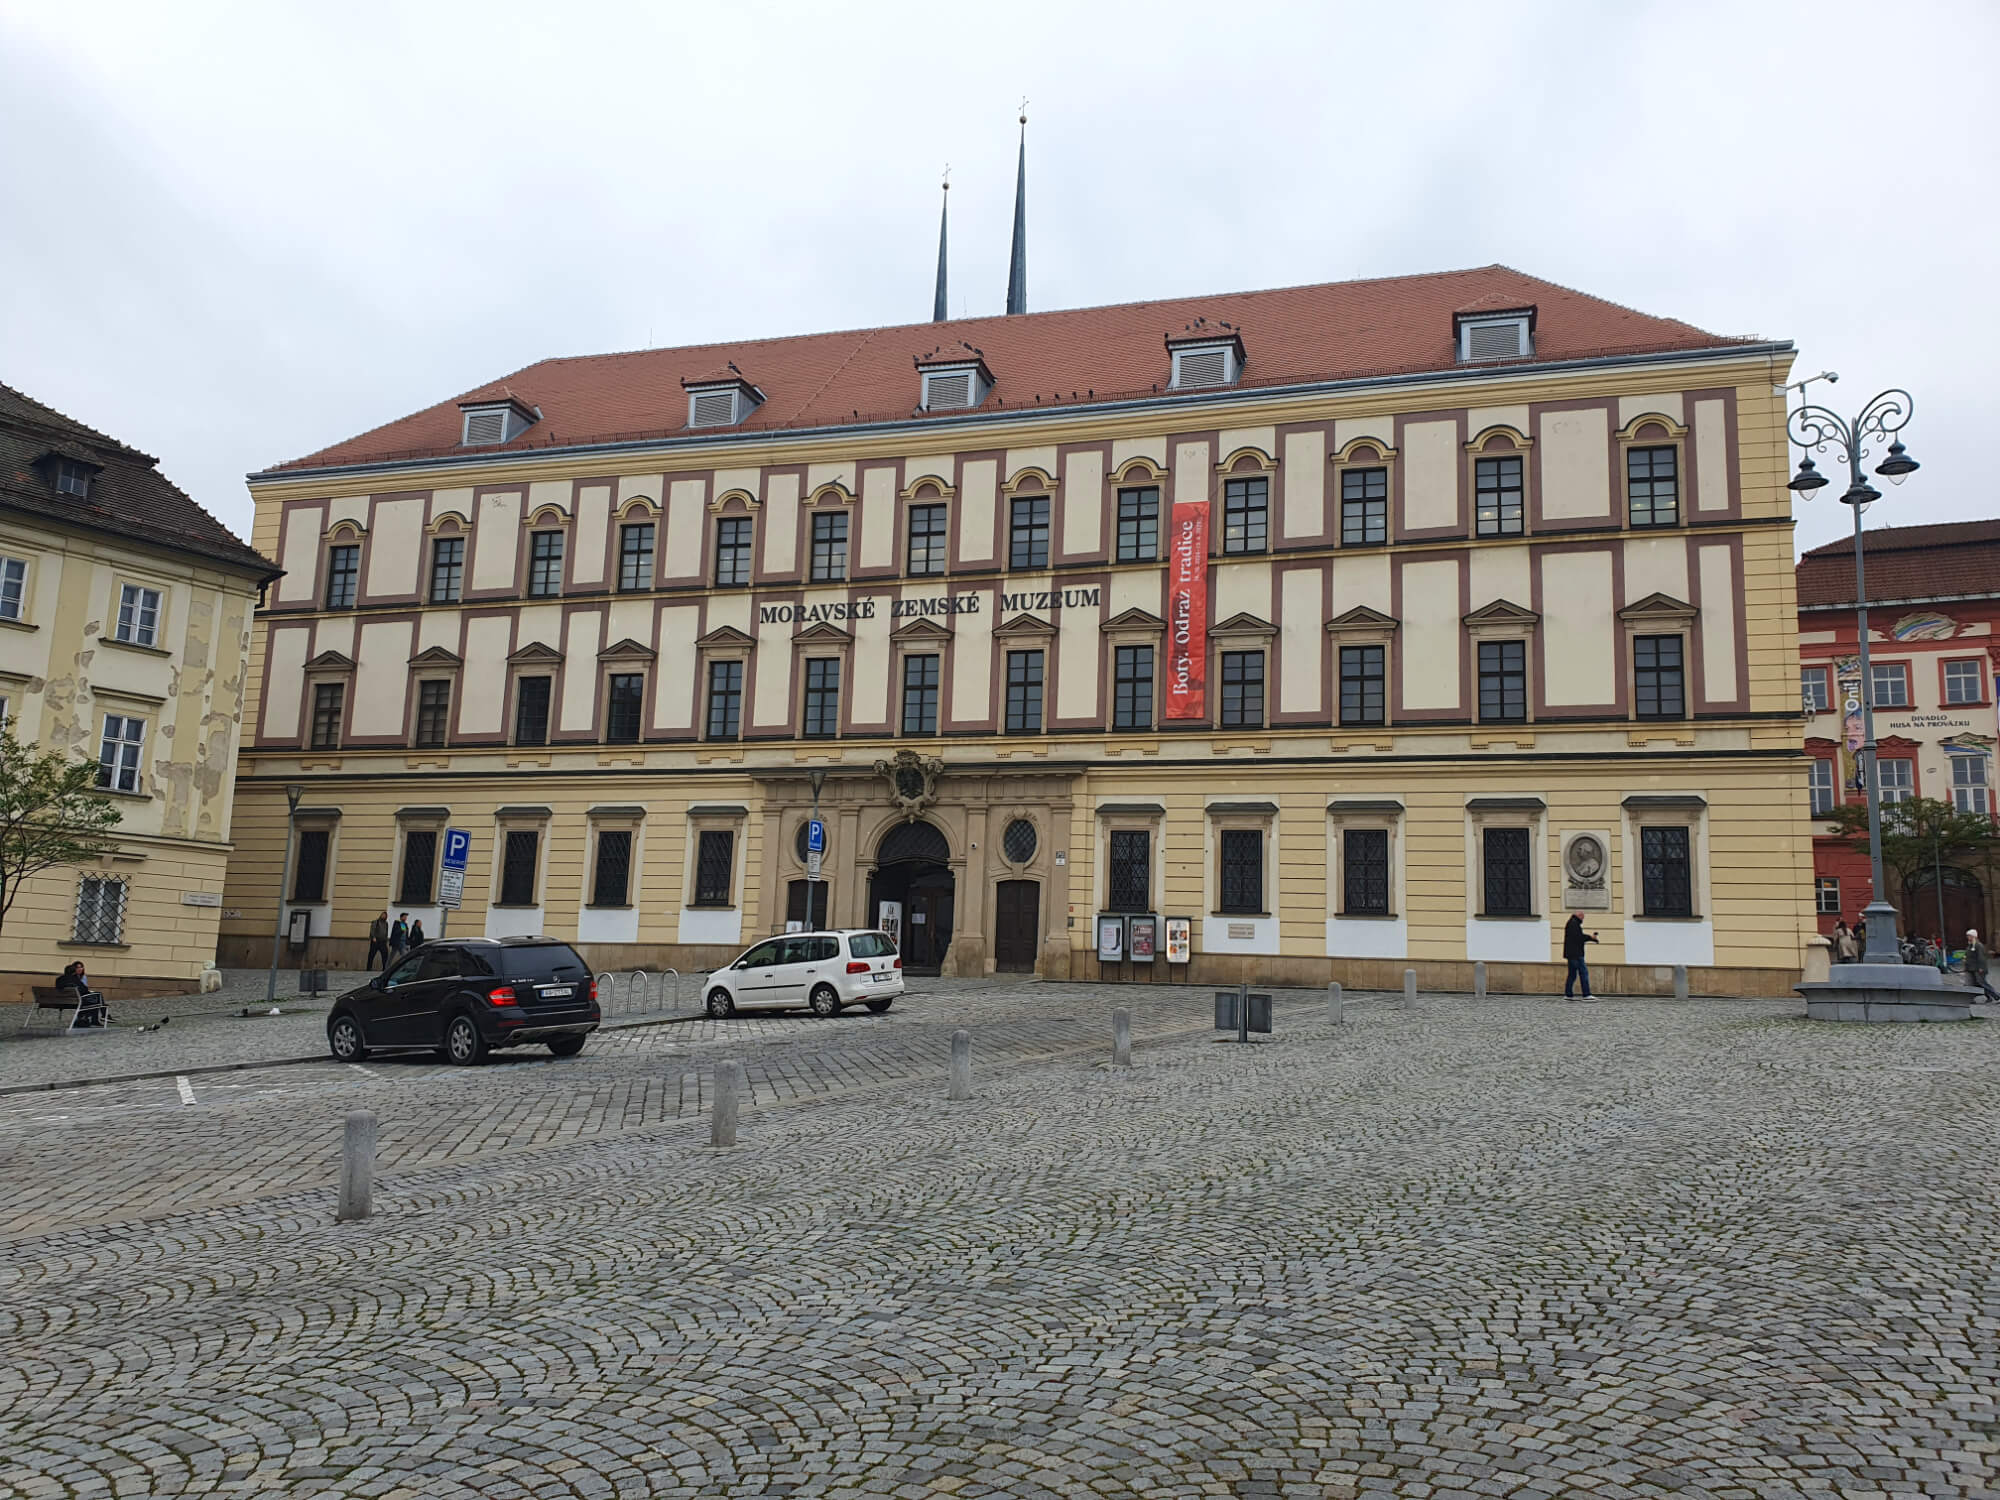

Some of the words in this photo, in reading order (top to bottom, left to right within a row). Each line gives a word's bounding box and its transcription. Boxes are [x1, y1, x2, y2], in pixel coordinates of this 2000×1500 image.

[1177, 521, 1193, 582] tradice
[760, 596, 875, 624] MORAVSKÉ
[891, 591, 980, 618] ZEMSKÉ
[1000, 588, 1100, 612] MUZEUM
[1173, 652, 1192, 695] Boty.
[1843, 682, 1859, 711] Oni!
[1911, 714, 1948, 722] DIVADLO
[450, 835, 465, 856] P
[812, 824, 820, 840] P
